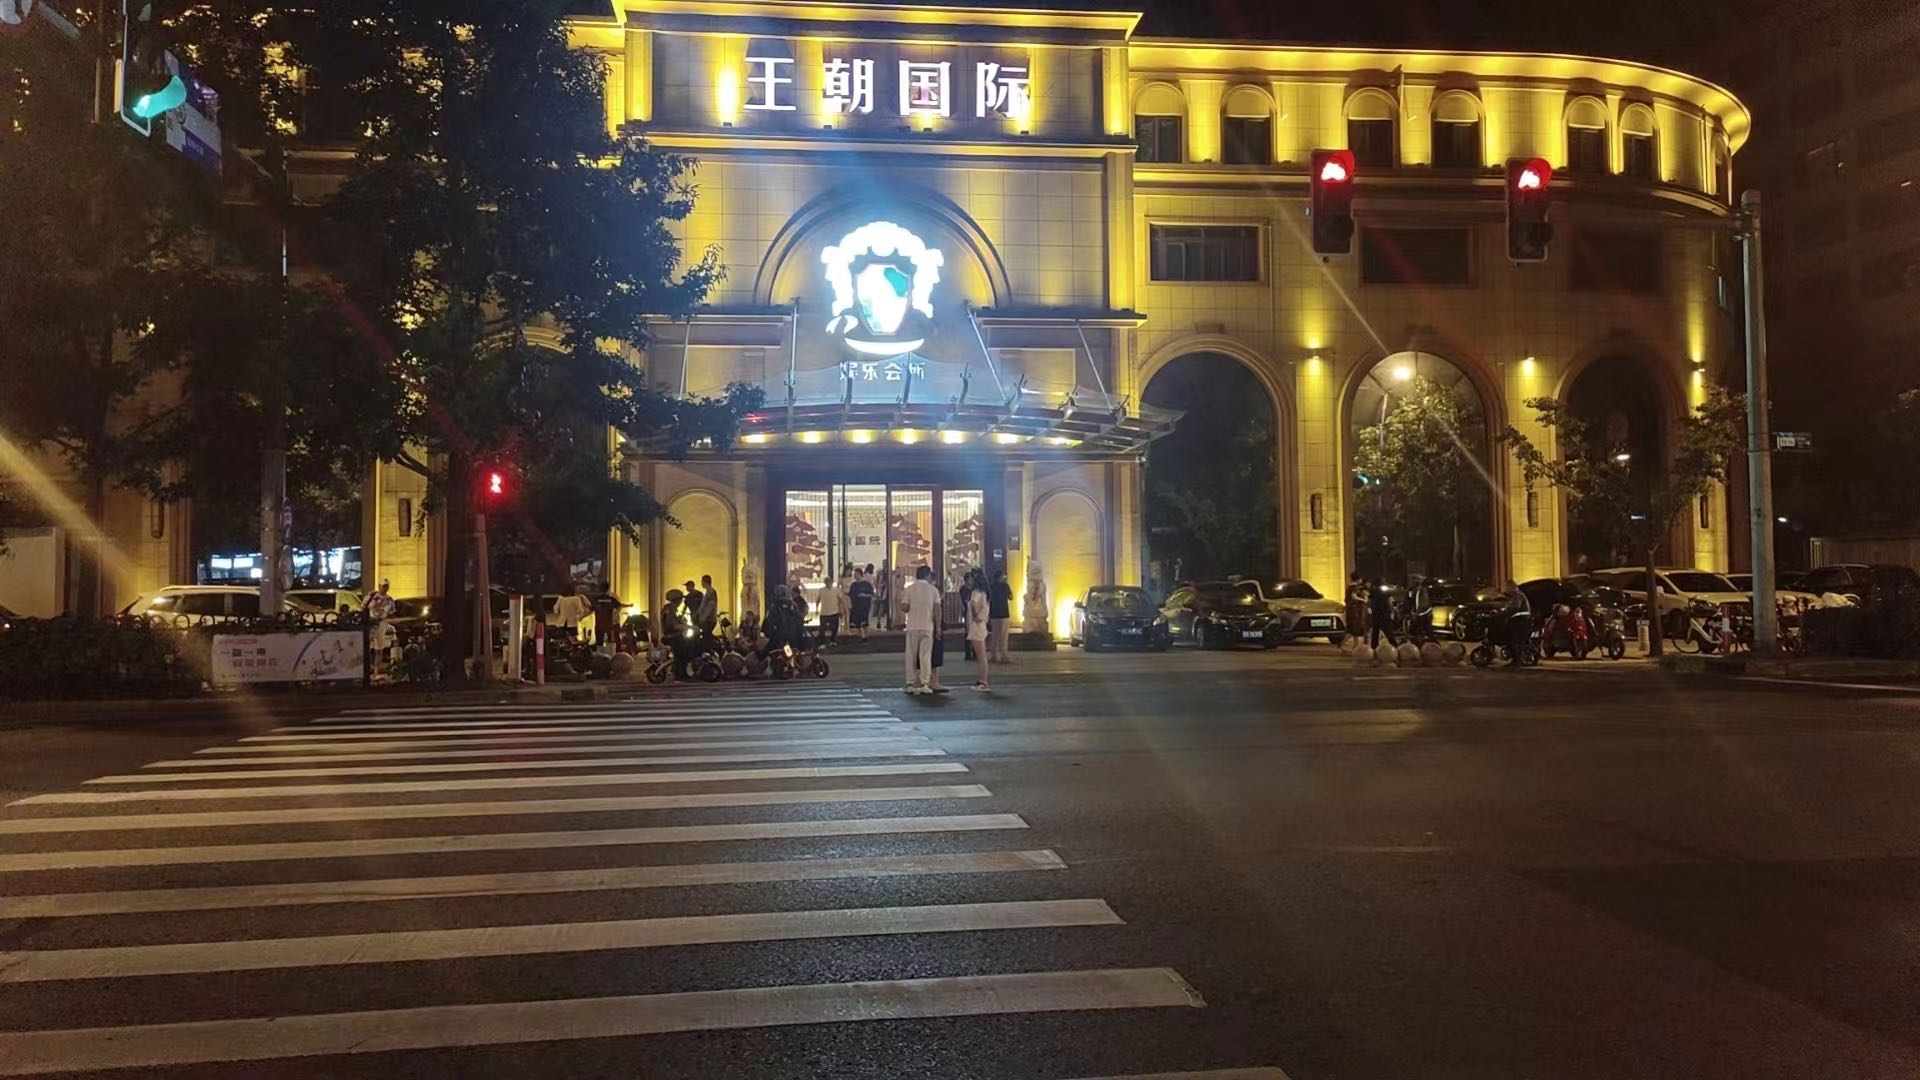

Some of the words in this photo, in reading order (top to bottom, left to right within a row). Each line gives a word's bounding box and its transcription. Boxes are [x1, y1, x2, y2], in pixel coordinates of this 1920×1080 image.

[744, 57, 1031, 117] 王朝国际
[839, 361, 926, 381] 娱乐会所
